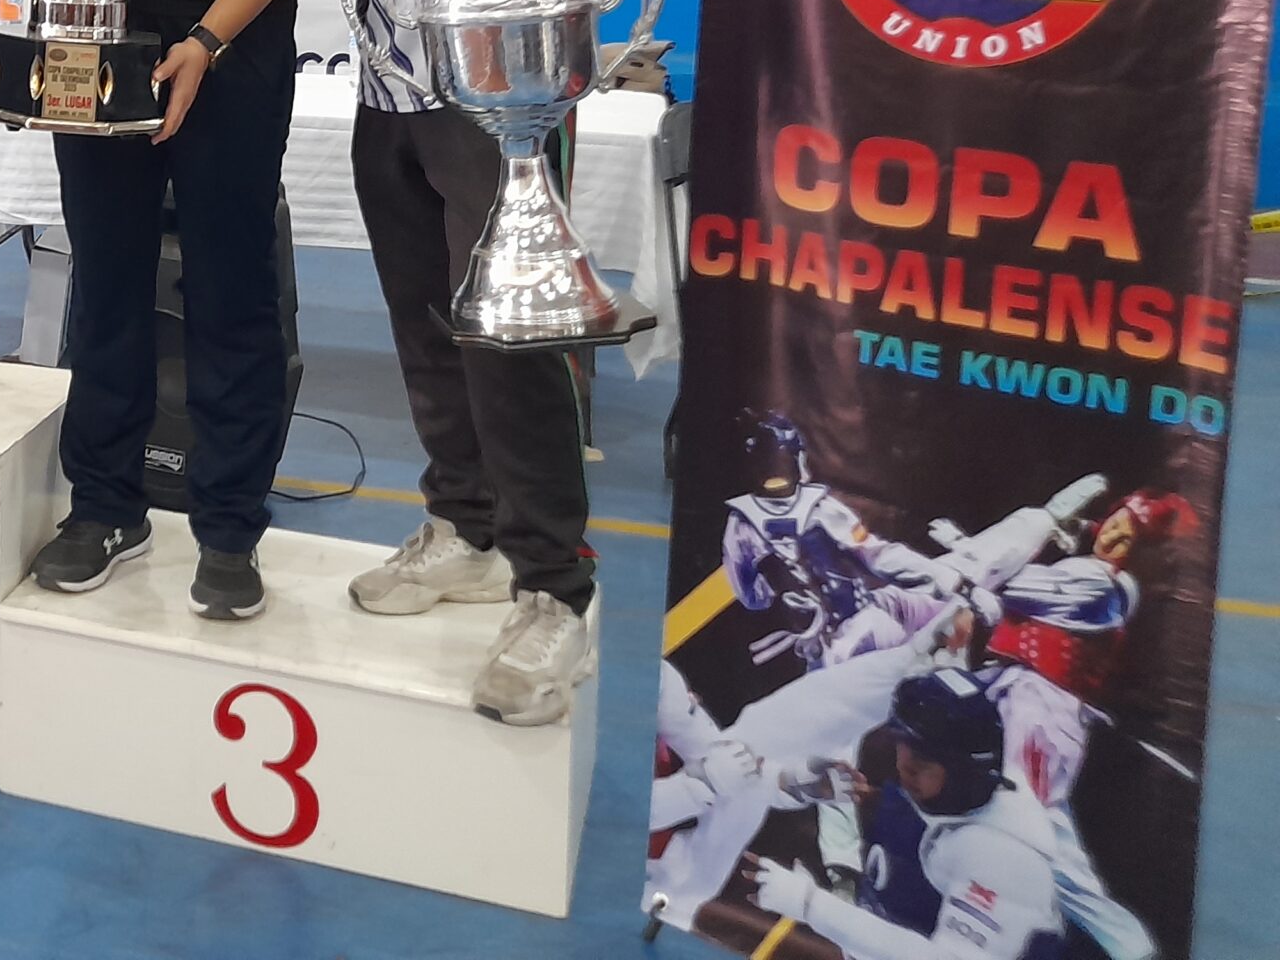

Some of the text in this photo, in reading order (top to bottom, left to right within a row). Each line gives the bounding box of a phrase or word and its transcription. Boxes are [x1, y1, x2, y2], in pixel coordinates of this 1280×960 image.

[881, 12, 1046, 58] UNION
[773, 124, 1141, 262] COPA
[688, 213, 1234, 375] CHAPALENSE
[853, 329, 1226, 437] TAE KWON DO
[210, 681, 320, 849] 3
